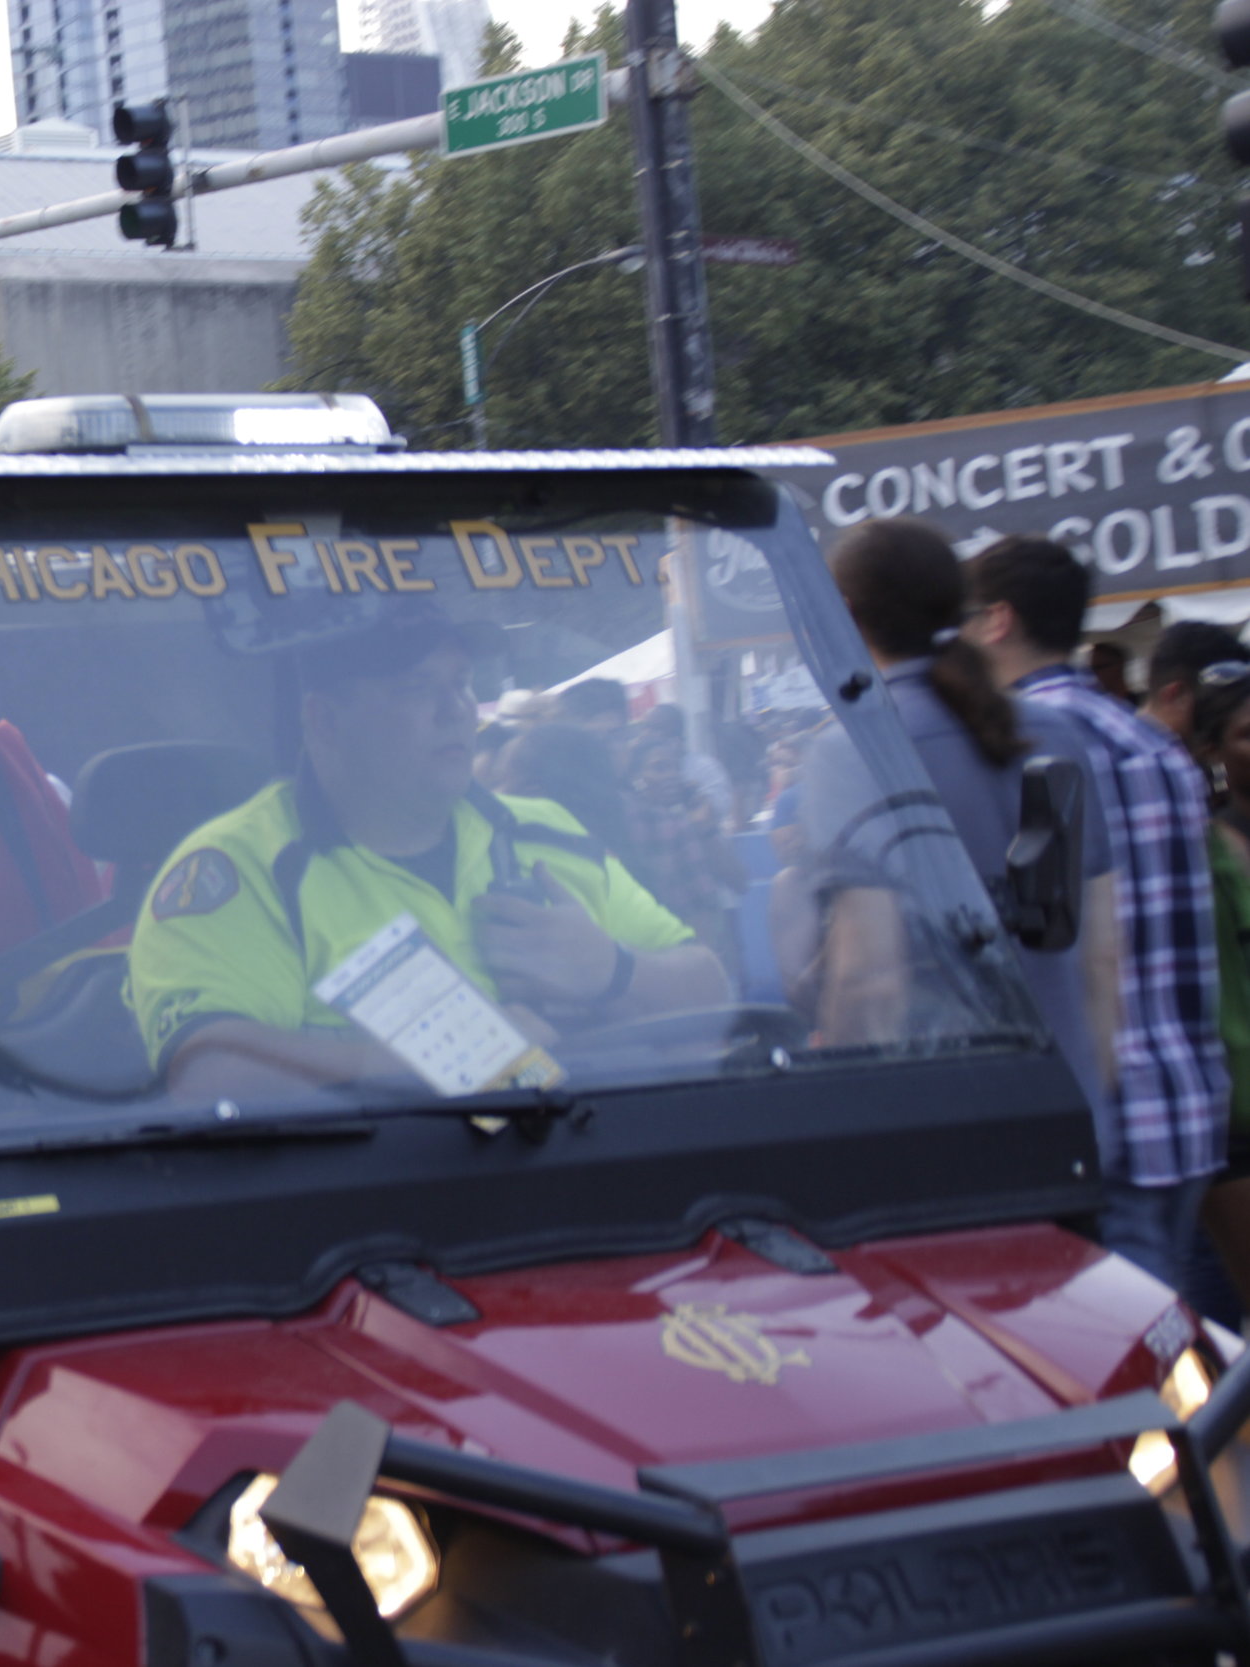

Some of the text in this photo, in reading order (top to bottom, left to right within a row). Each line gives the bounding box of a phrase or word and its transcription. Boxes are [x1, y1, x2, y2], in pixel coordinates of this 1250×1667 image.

[463, 69, 567, 121] JACKSON
[822, 432, 1136, 527] CONCERT
[1156, 425, 1215, 484] &
[246, 522, 436, 595] FIRE
